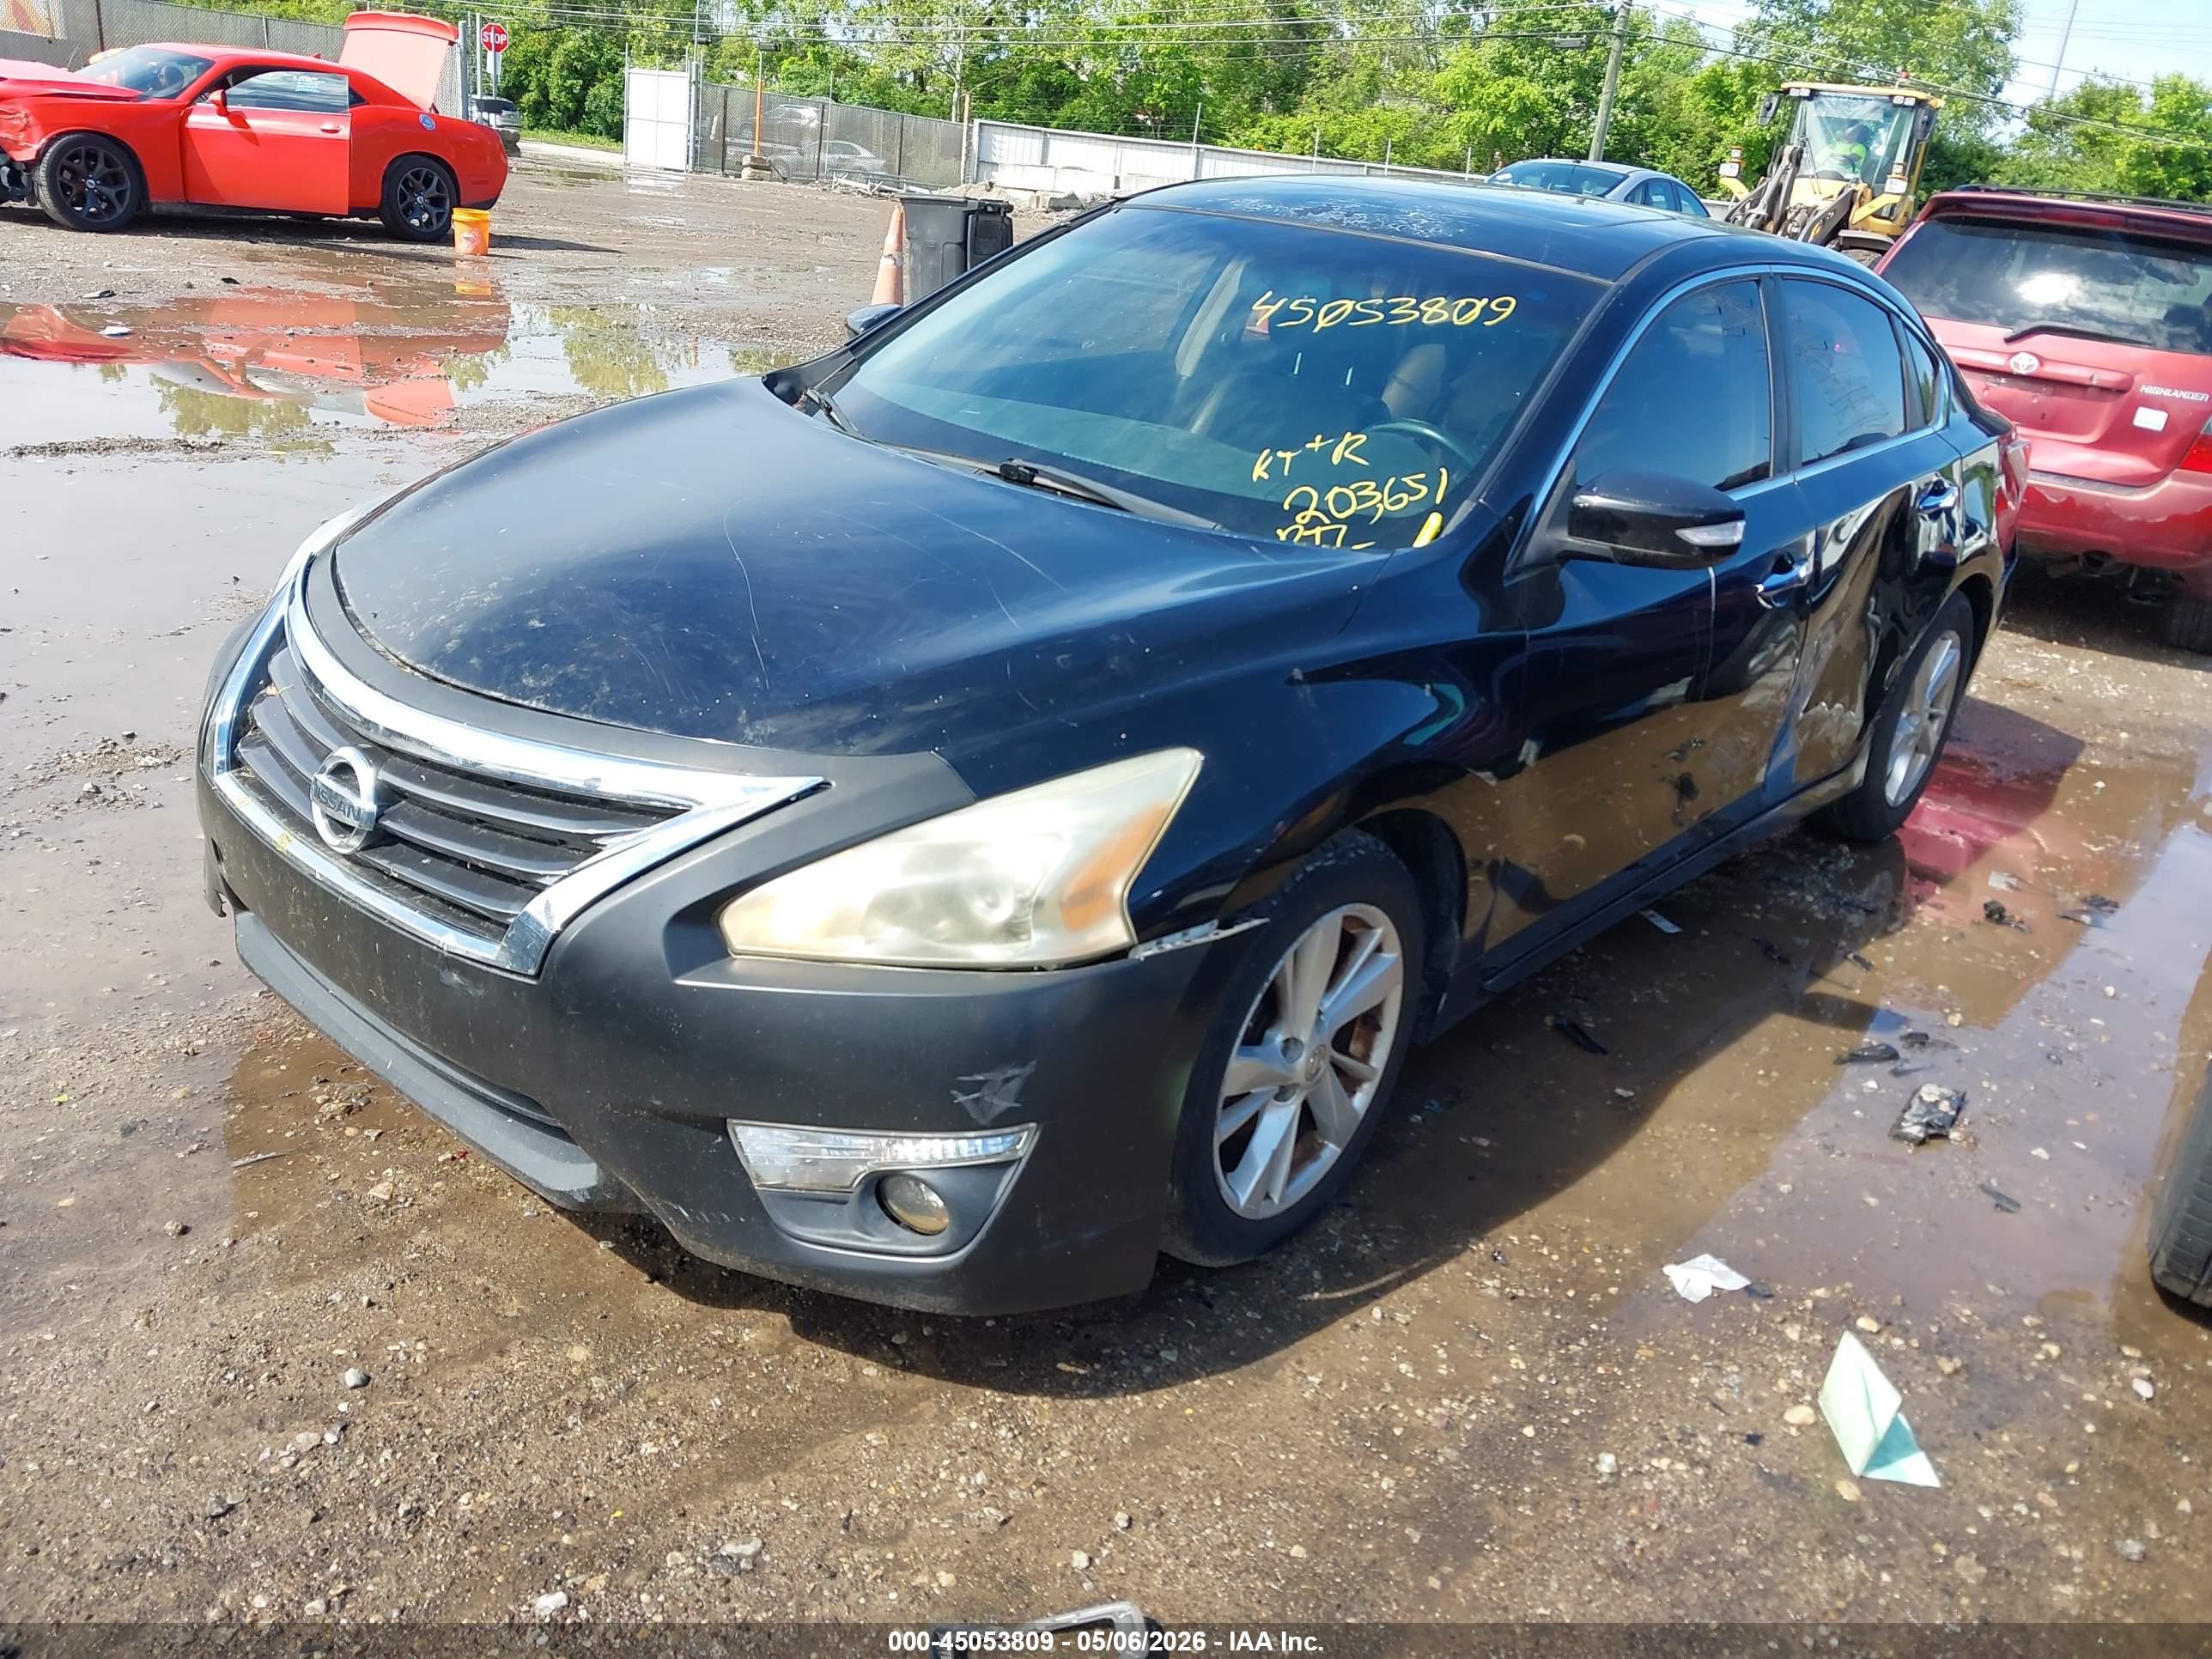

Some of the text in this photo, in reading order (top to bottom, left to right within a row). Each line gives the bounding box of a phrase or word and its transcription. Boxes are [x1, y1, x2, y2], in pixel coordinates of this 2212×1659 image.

[1251, 290, 1516, 333] 45053809
[2139, 385, 2210, 402] HIGHLANDER
[1283, 467, 1449, 526] 203,651
[313, 780, 362, 822] NISSAN
